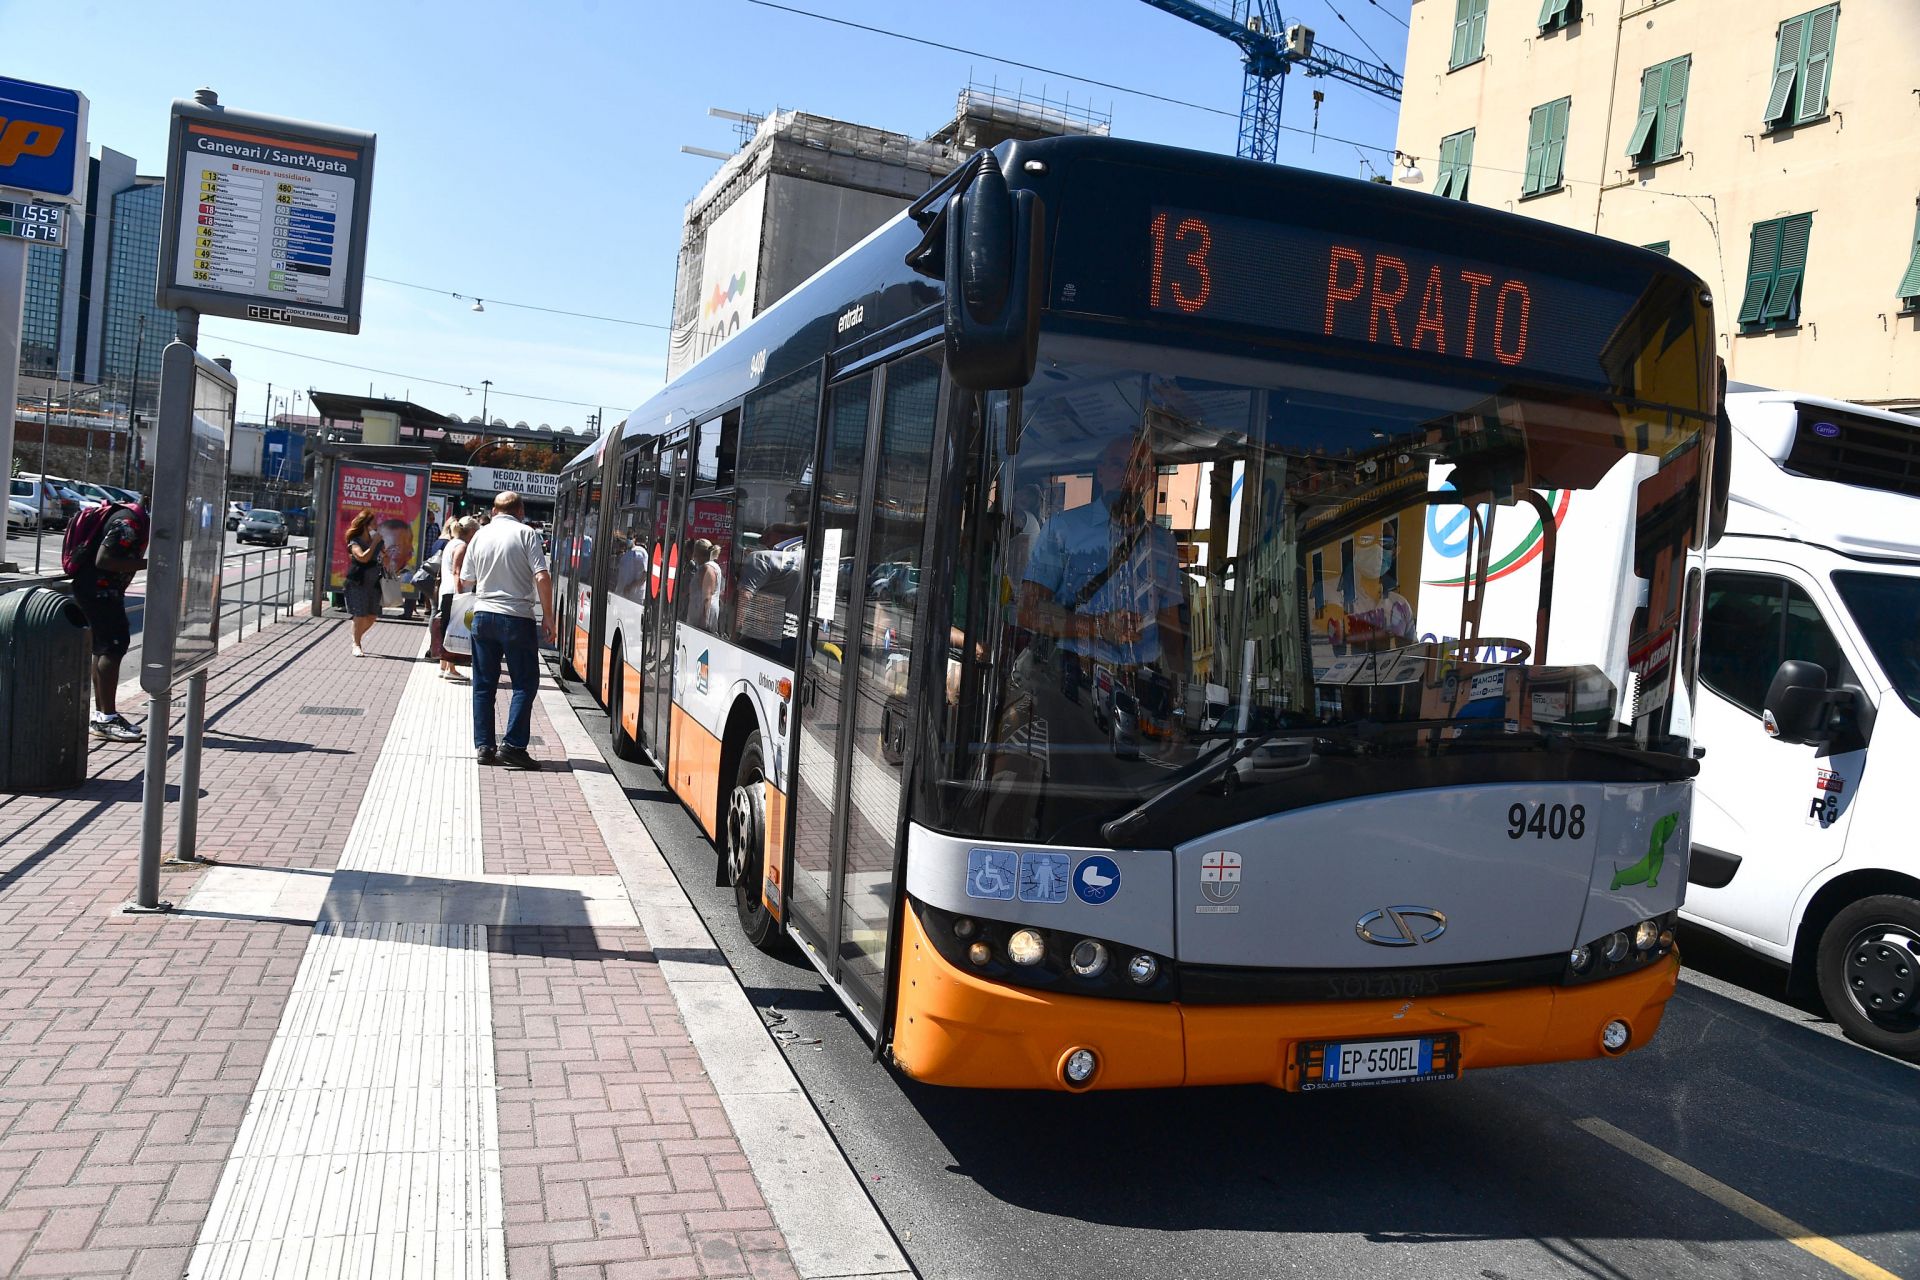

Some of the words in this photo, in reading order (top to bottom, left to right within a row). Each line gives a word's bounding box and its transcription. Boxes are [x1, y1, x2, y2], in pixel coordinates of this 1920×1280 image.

[197, 137, 261, 160] Canevari
[272, 150, 347, 173] Sant'Agata
[208, 172, 217, 181] 13
[241, 165, 271, 176] Fermata
[273, 171, 312, 183] sussidiaria
[207, 183, 216, 192] 14
[278, 183, 292, 193] 480
[277, 194, 291, 204] 482
[205, 205, 214, 214] 18
[276, 206, 290, 214] 603
[204, 217, 213, 225] 18
[275, 217, 289, 225] 604
[203, 228, 212, 236] 46
[274, 228, 288, 236] 618
[202, 239, 211, 247] 47
[273, 239, 287, 247] 649
[201, 250, 210, 259] 49
[272, 250, 286, 258] 656
[200, 261, 209, 270] 82
[193, 271, 208, 281] 356
[1149, 210, 1212, 313] 13
[1323, 244, 1532, 367] PRATO
[286, 308, 306, 316] CODICE
[306, 311, 330, 319] FERMATA
[838, 304, 864, 333] entrata
[1816, 425, 1836, 434] Carrier
[344, 475, 355, 483] IN
[356, 477, 394, 488] QUESTO
[343, 483, 378, 493] SPAZIO
[493, 480, 524, 492] CINEMA
[527, 484, 556, 495] MULTIS
[343, 490, 368, 499] VALE
[369, 493, 403, 504] TUTTO.
[1507, 802, 1586, 840] 9408
[1327, 972, 1441, 998] SOLARIS
[1316, 1082, 1347, 1090] SOLARIS
